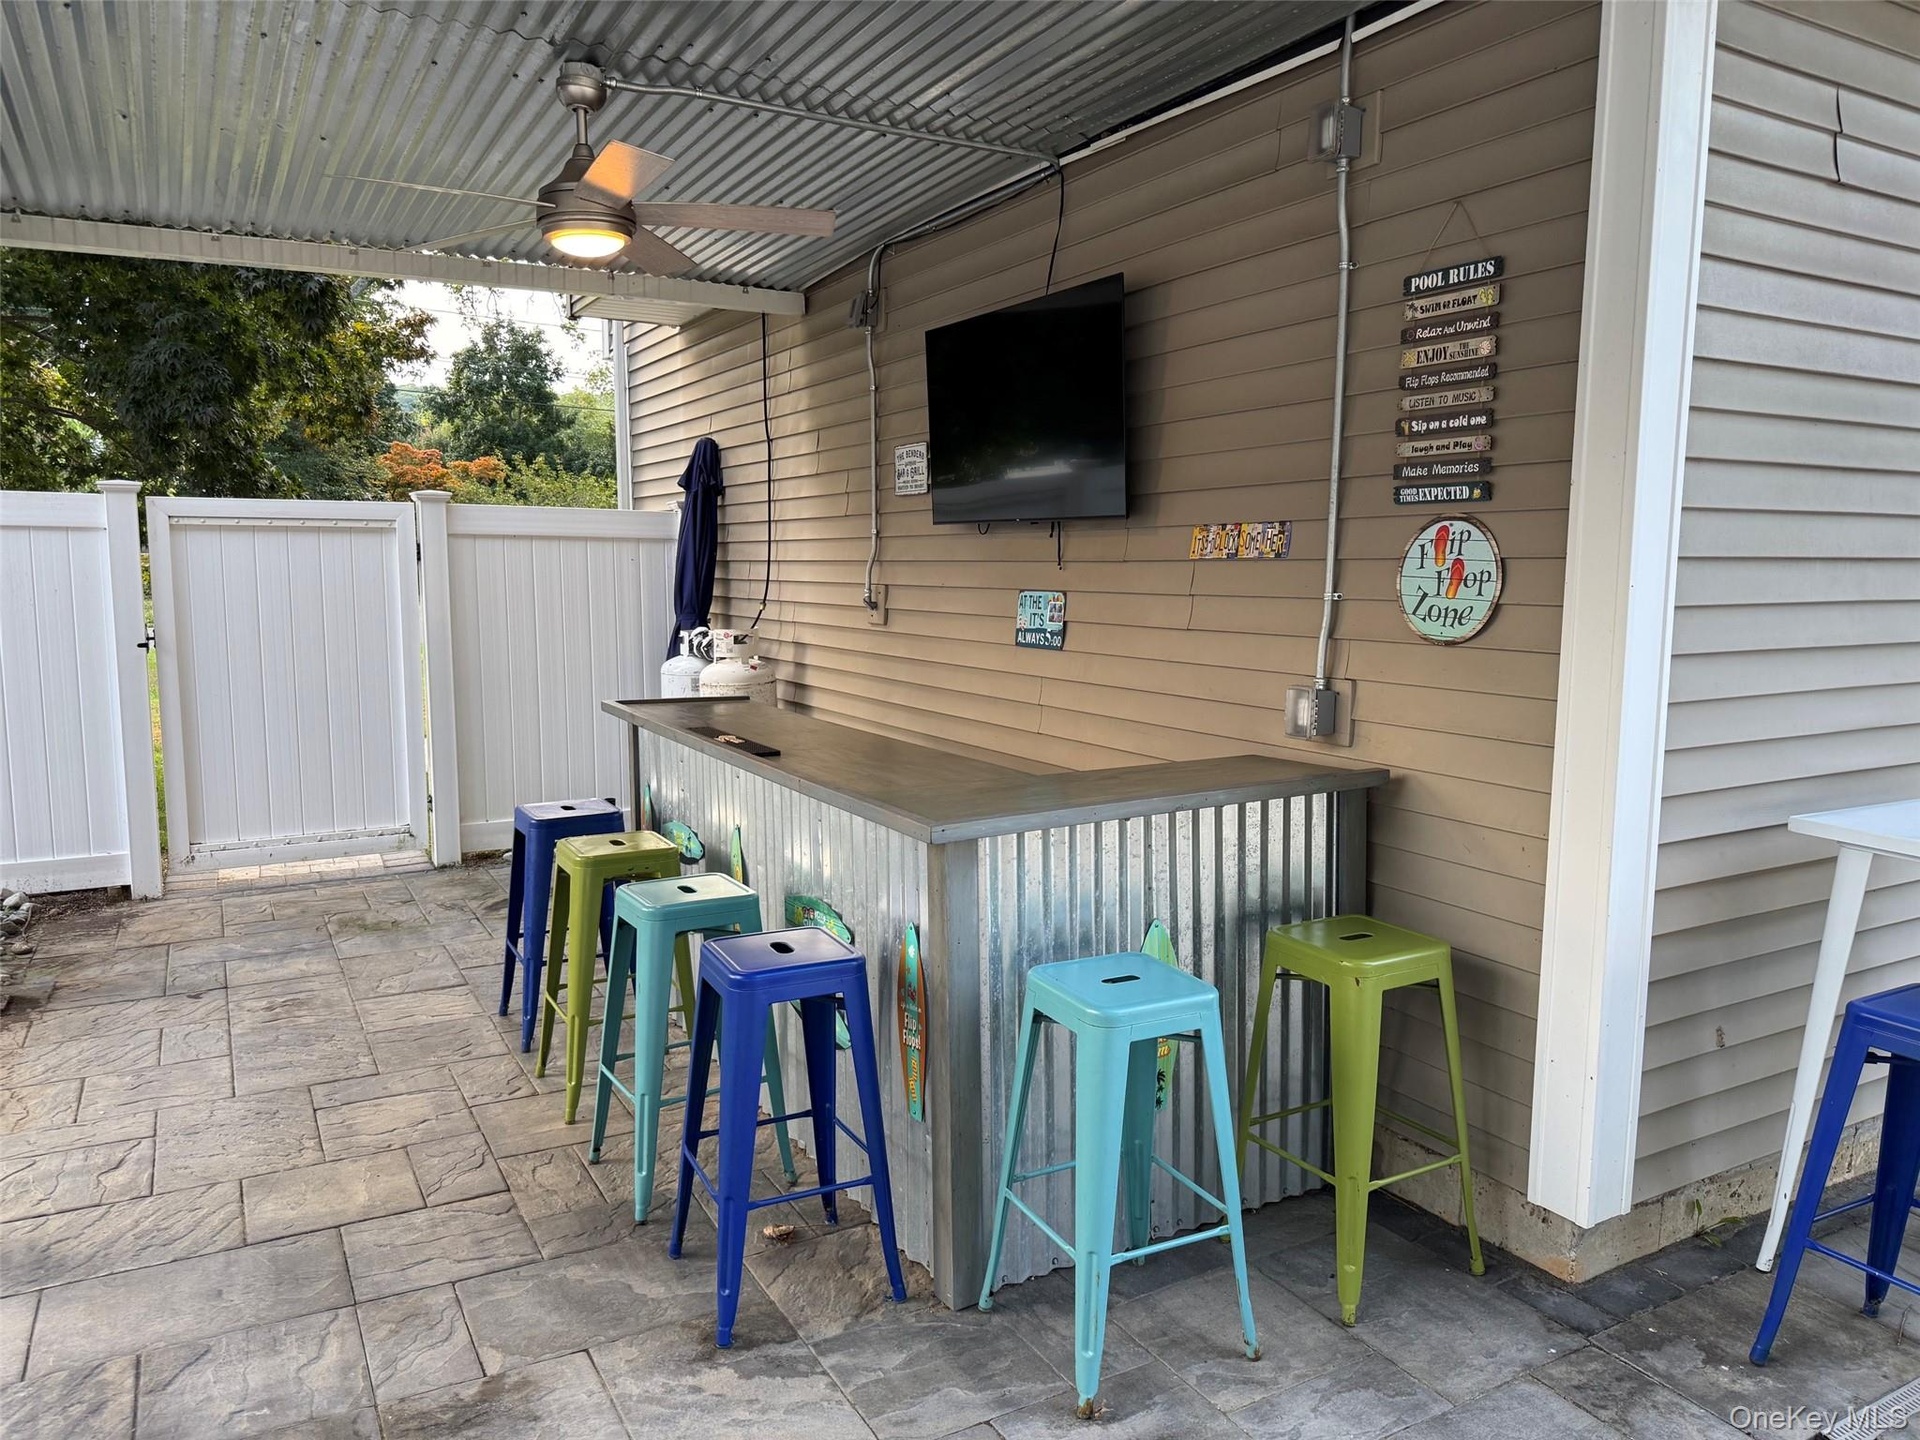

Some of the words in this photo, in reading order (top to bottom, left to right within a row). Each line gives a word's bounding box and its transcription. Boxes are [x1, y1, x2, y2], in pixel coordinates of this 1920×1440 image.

[1410, 271, 1445, 293] POOL
[1449, 260, 1495, 284] RULES
[1420, 303, 1441, 315] SWIM
[1452, 294, 1478, 309] FLOAT
[1416, 326, 1442, 339] Relax
[1456, 315, 1491, 332] Unwind
[1416, 346, 1450, 364] ENJOY
[1459, 342, 1470, 350] THE
[1449, 348, 1479, 360] SUNSHINE
[1405, 376, 1419, 388] Flip
[1420, 374, 1439, 386] Flops
[1440, 365, 1490, 382] Recommended
[1408, 397, 1435, 409] LISTEN
[1439, 395, 1448, 405] TO
[1451, 391, 1477, 403] MUSIC
[1411, 420, 1427, 433] Sip
[1428, 421, 1440, 430] on
[1441, 420, 1447, 429] a
[1449, 415, 1468, 428] cold
[1469, 415, 1487, 426] one
[1435, 442, 1451, 451] and
[1452, 440, 1473, 450] Play
[1402, 466, 1428, 477] Make
[1432, 462, 1480, 475] Memories
[1400, 495, 1419, 503] TIMES
[1418, 485, 1470, 501] EXPECTED
[1019, 595, 1028, 609] AT
[1029, 595, 1043, 610] THE
[1412, 585, 1474, 629] Zone
[1029, 612, 1045, 627] IT'S
[1017, 631, 1045, 645] ALWAYS
[904, 1012, 917, 1033] Flip
